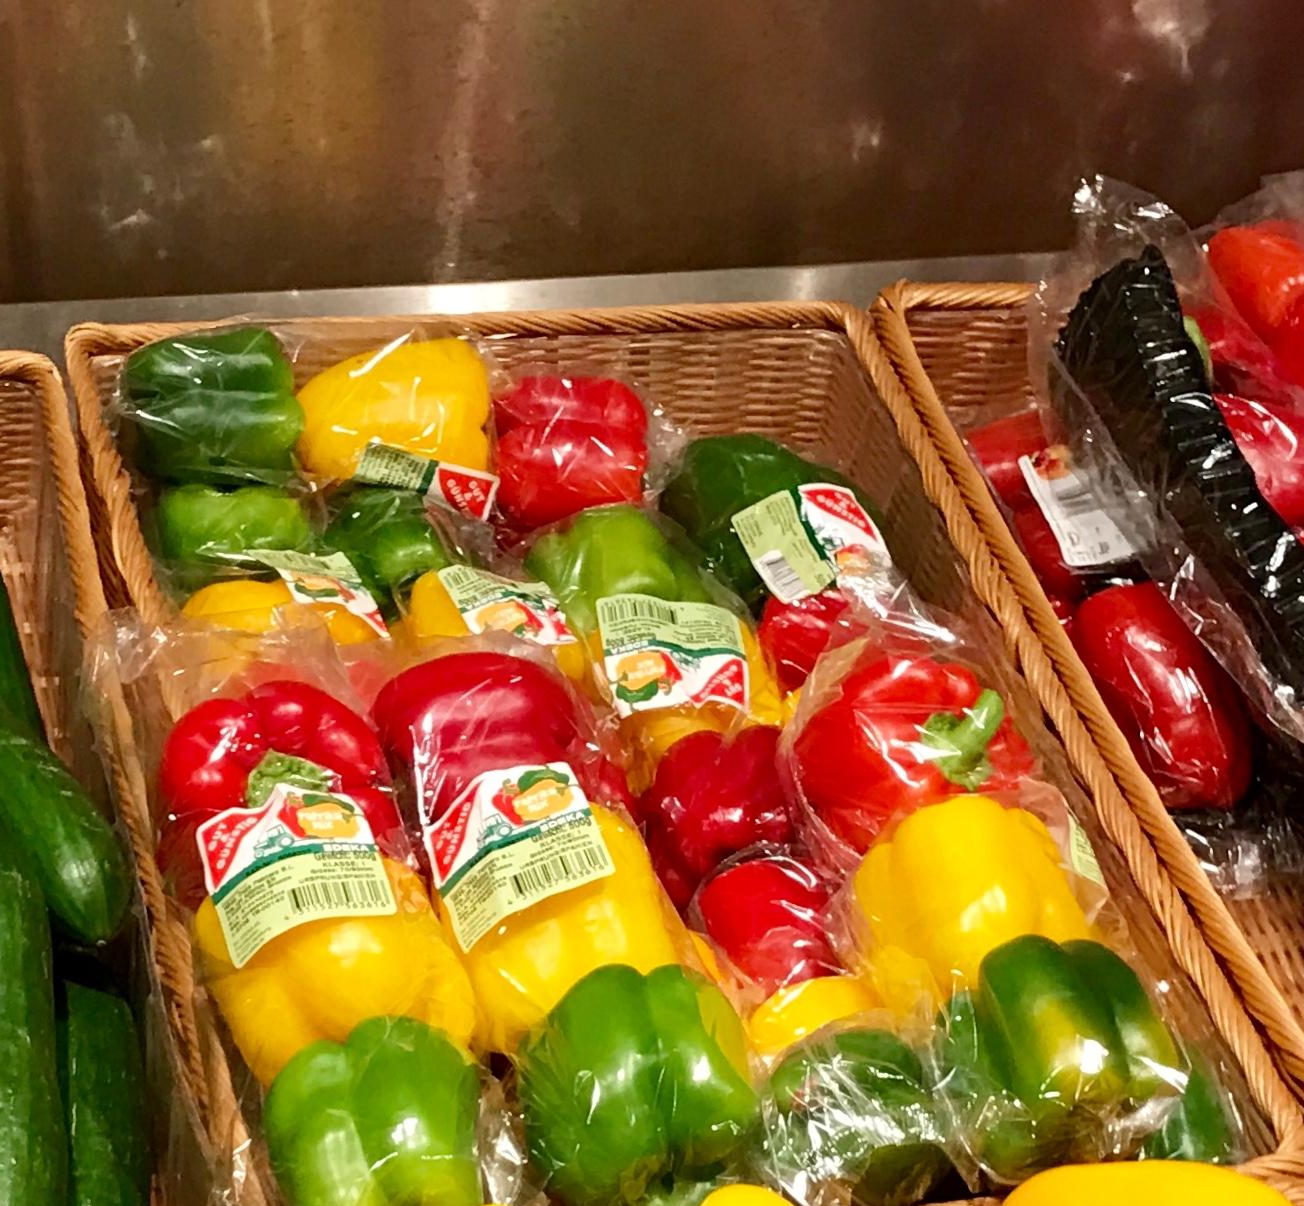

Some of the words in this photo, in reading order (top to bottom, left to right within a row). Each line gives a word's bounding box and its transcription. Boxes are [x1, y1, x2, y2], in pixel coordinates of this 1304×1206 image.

[468, 480, 485, 502] GUT
[540, 810, 585, 832] EDEKA
[208, 822, 228, 852] GUT
[322, 843, 371, 854] EDEKA
